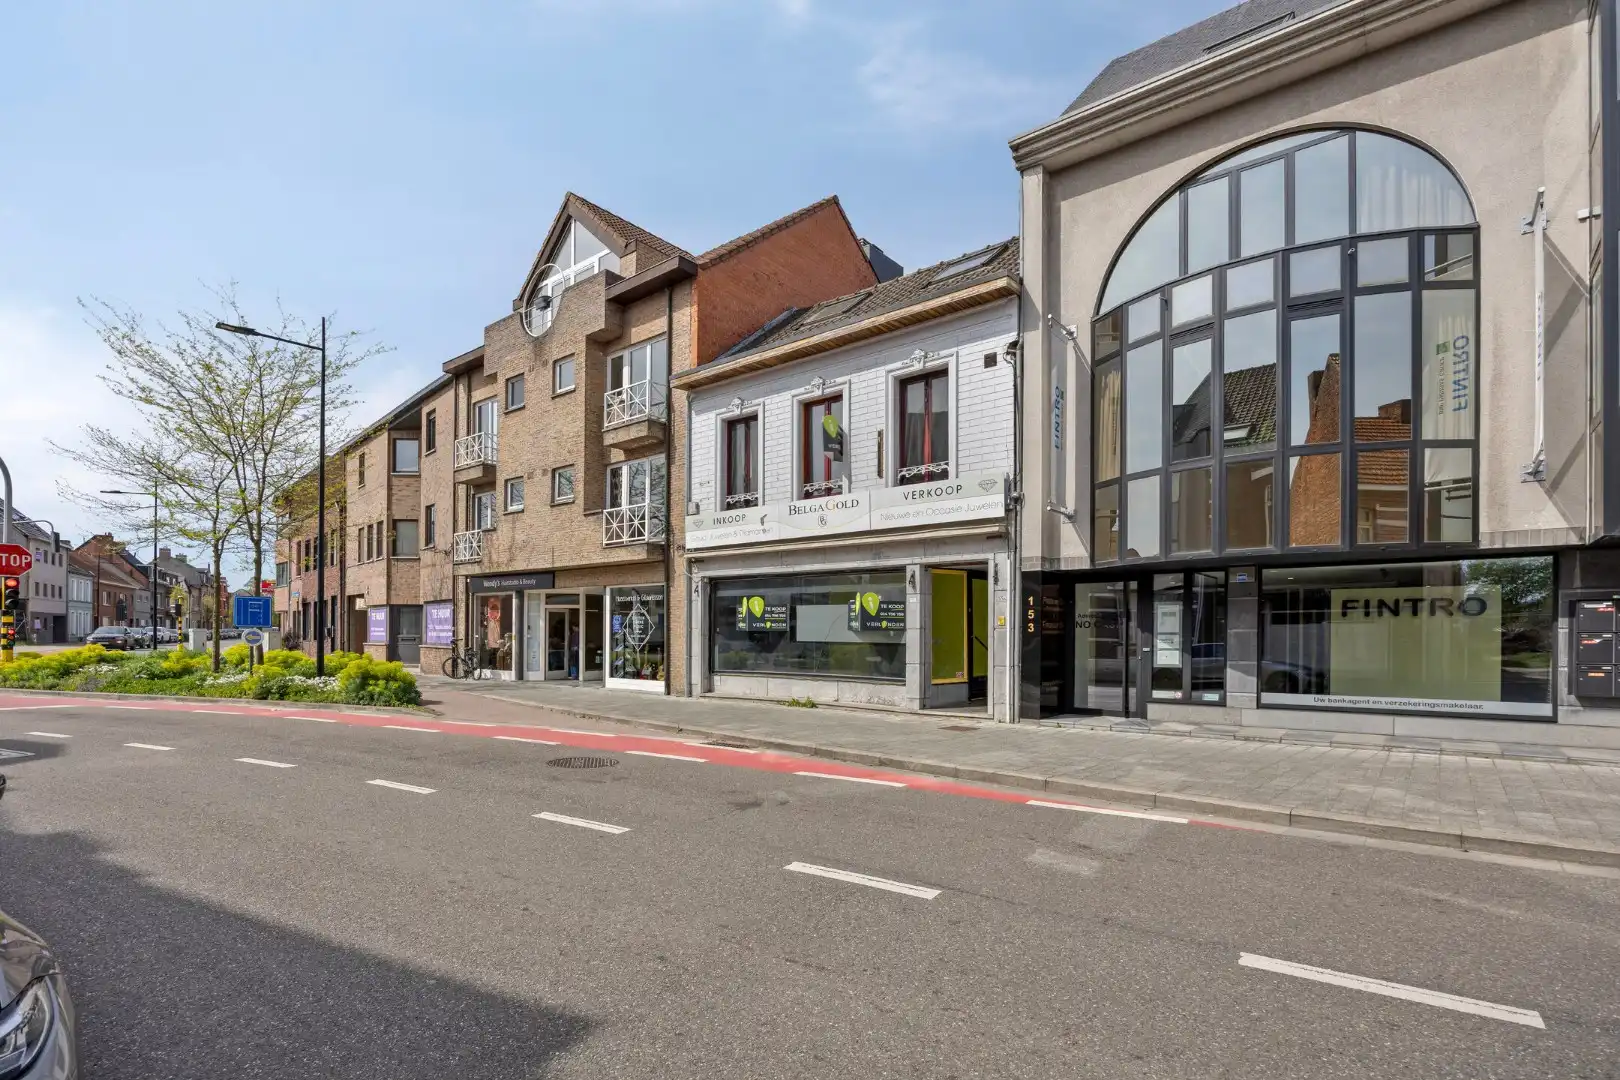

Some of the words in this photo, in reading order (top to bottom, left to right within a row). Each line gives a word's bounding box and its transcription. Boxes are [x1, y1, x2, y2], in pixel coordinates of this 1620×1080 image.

[903, 485, 963, 500] VERKOOP
[965, 500, 1004, 513] Juwelen
[713, 513, 747, 526] INKOOP
[0, 553, 31, 567] TOP
[1341, 597, 1487, 618] FINTRO
[1328, 697, 1370, 706] bankagent
